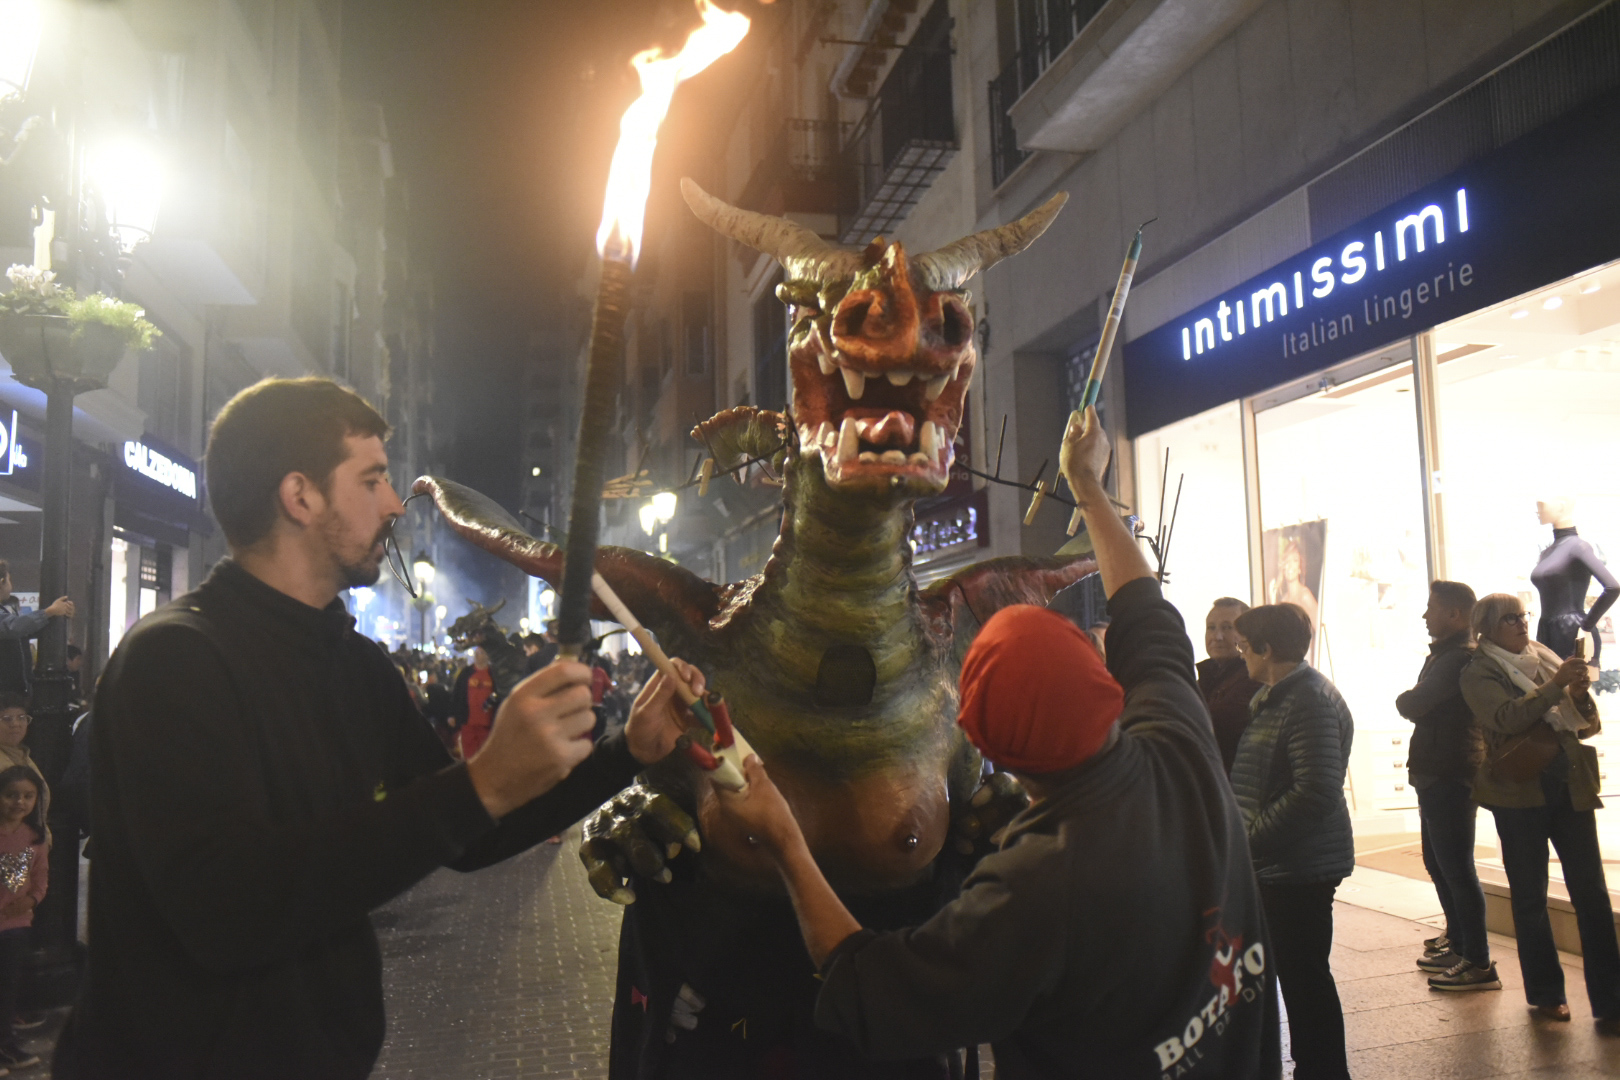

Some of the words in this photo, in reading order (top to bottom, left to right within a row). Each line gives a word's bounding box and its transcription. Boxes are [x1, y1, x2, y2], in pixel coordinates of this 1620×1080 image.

[1181, 188, 1471, 361] intimissimi
[1282, 313, 1355, 358] Italian
[1364, 262, 1474, 326] lingerie
[124, 441, 197, 500] CALZEDONIA
